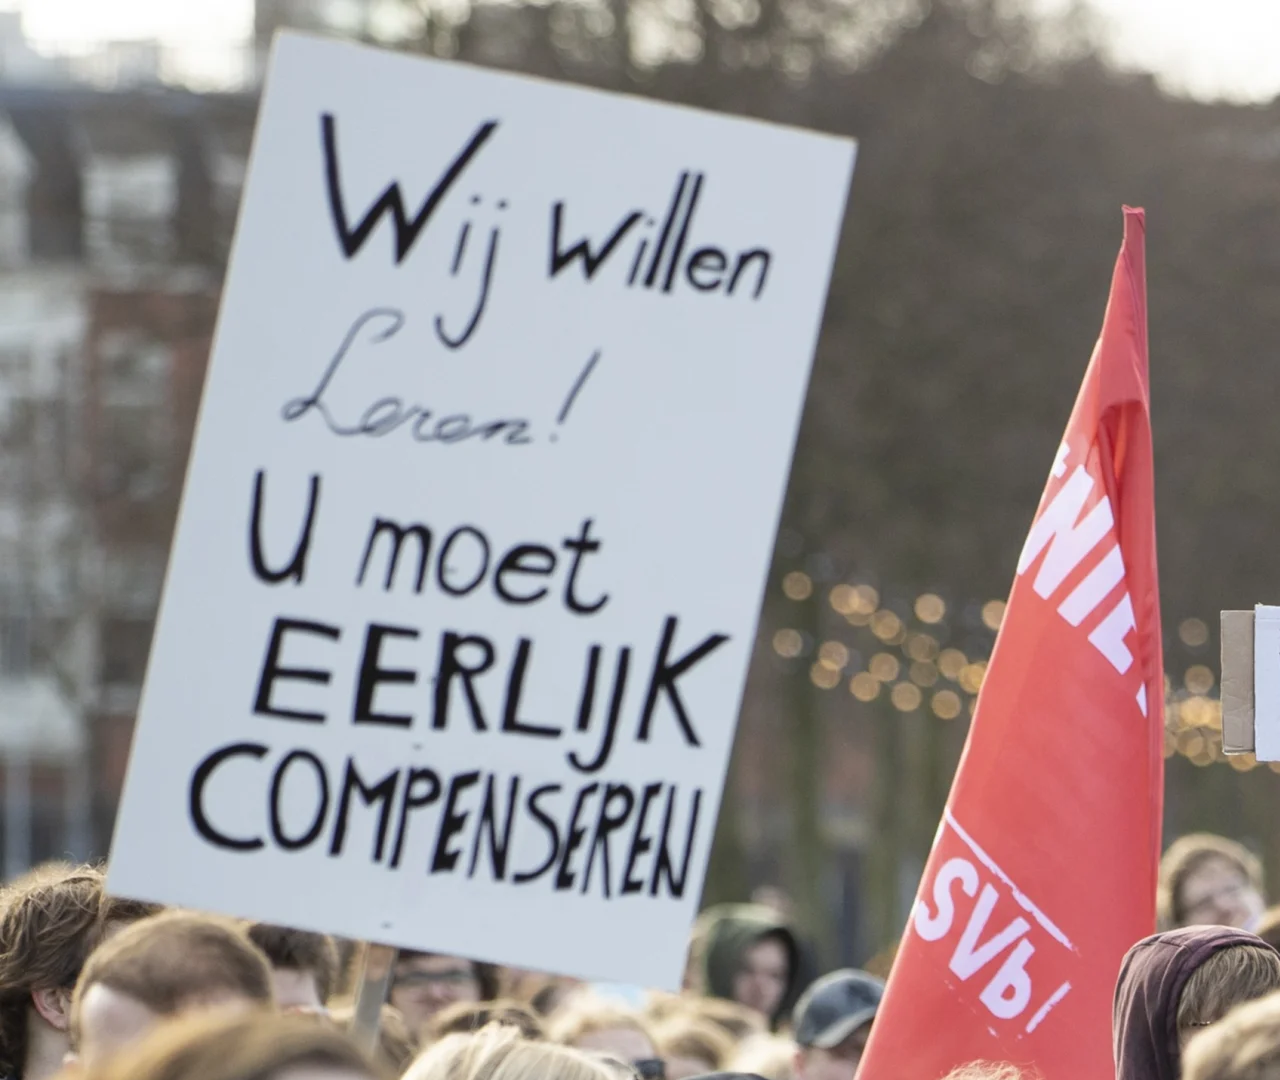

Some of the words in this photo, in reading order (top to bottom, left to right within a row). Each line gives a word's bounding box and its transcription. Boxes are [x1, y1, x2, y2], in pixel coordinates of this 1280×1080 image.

[320, 112, 510, 349] Wij
[282, 307, 602, 445] Leren!
[355, 517, 609, 616] moet
[188, 741, 704, 901] COMPENSEREN
